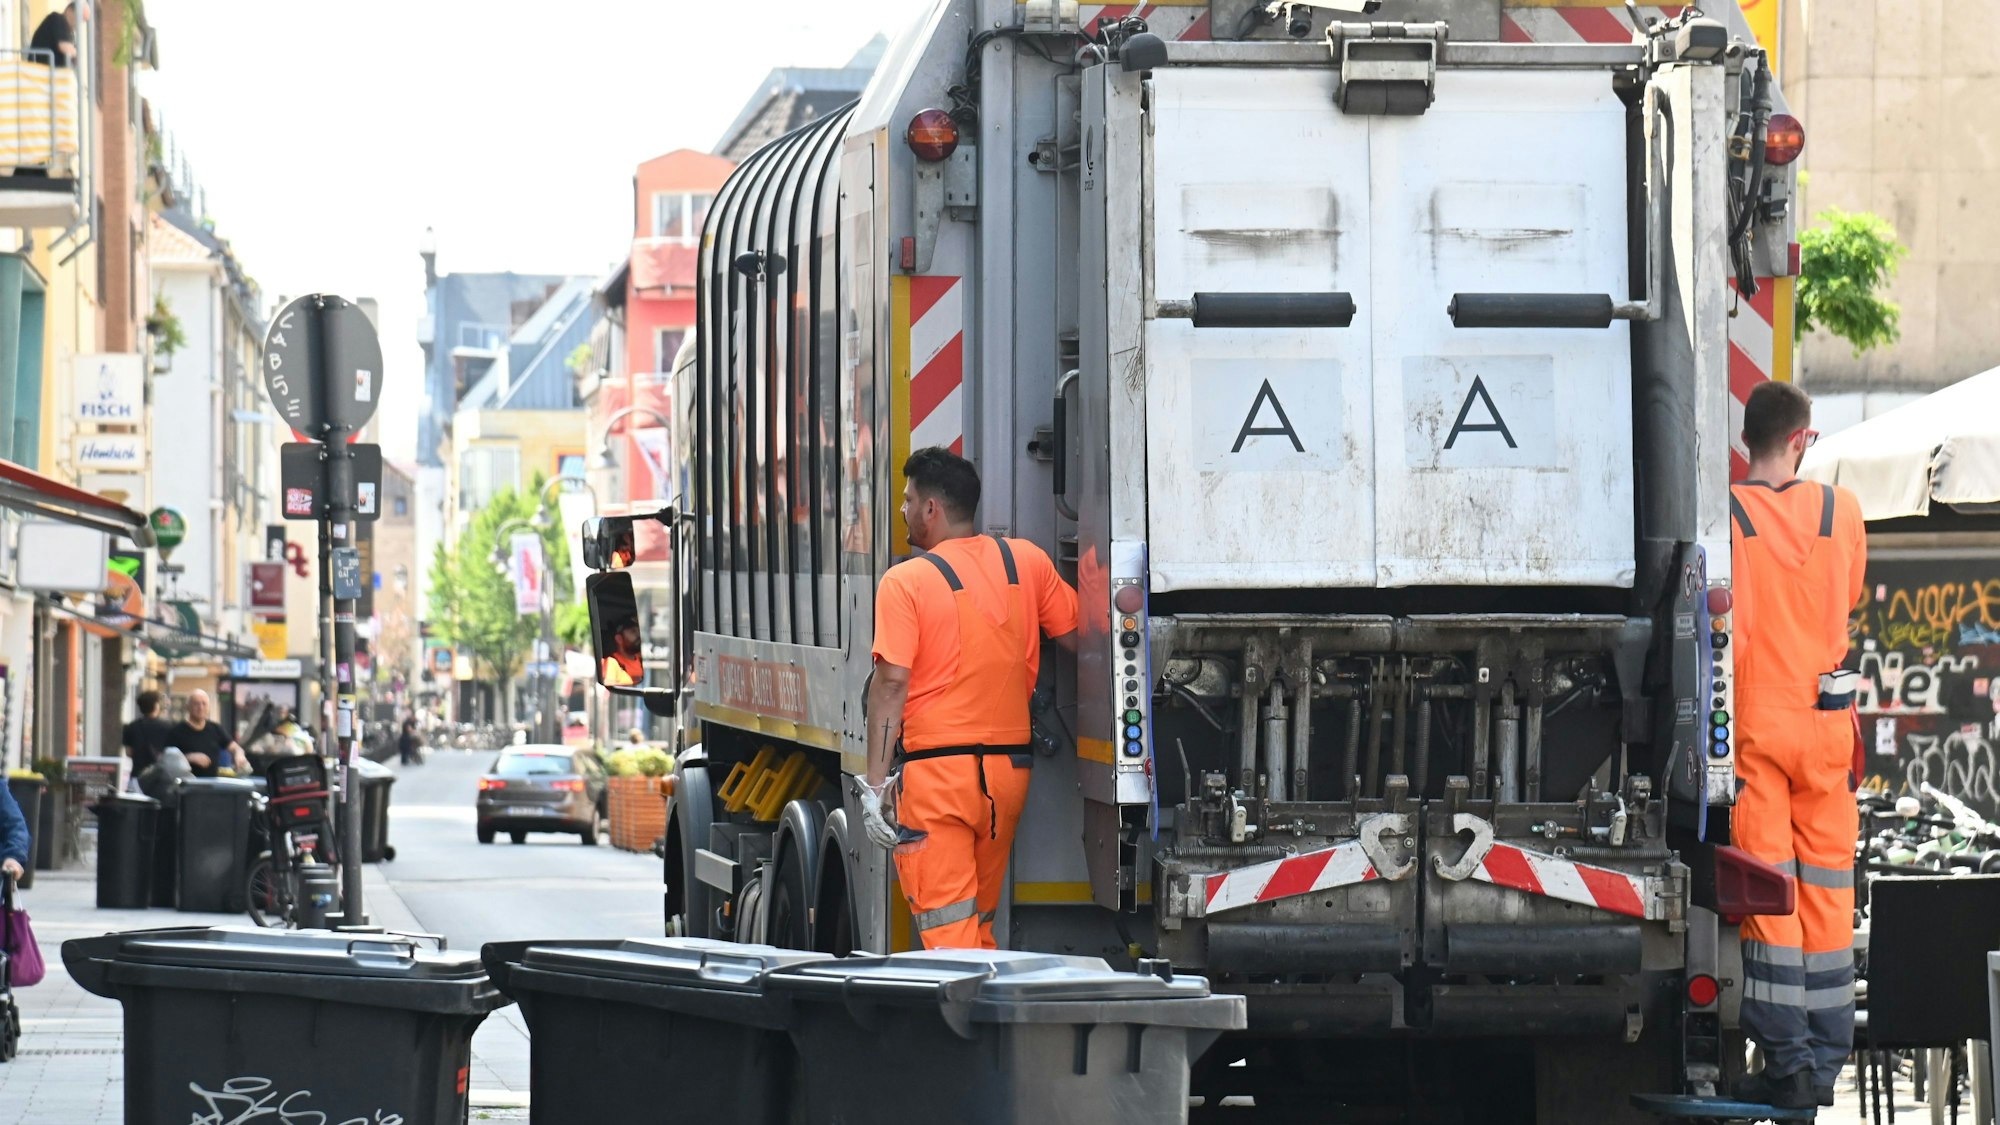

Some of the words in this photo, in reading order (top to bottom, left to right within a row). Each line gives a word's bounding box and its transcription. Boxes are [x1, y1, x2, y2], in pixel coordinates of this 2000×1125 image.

[81, 403, 131, 417] FISCH
[1231, 378, 1305, 452] A
[1443, 374, 1518, 449] A
